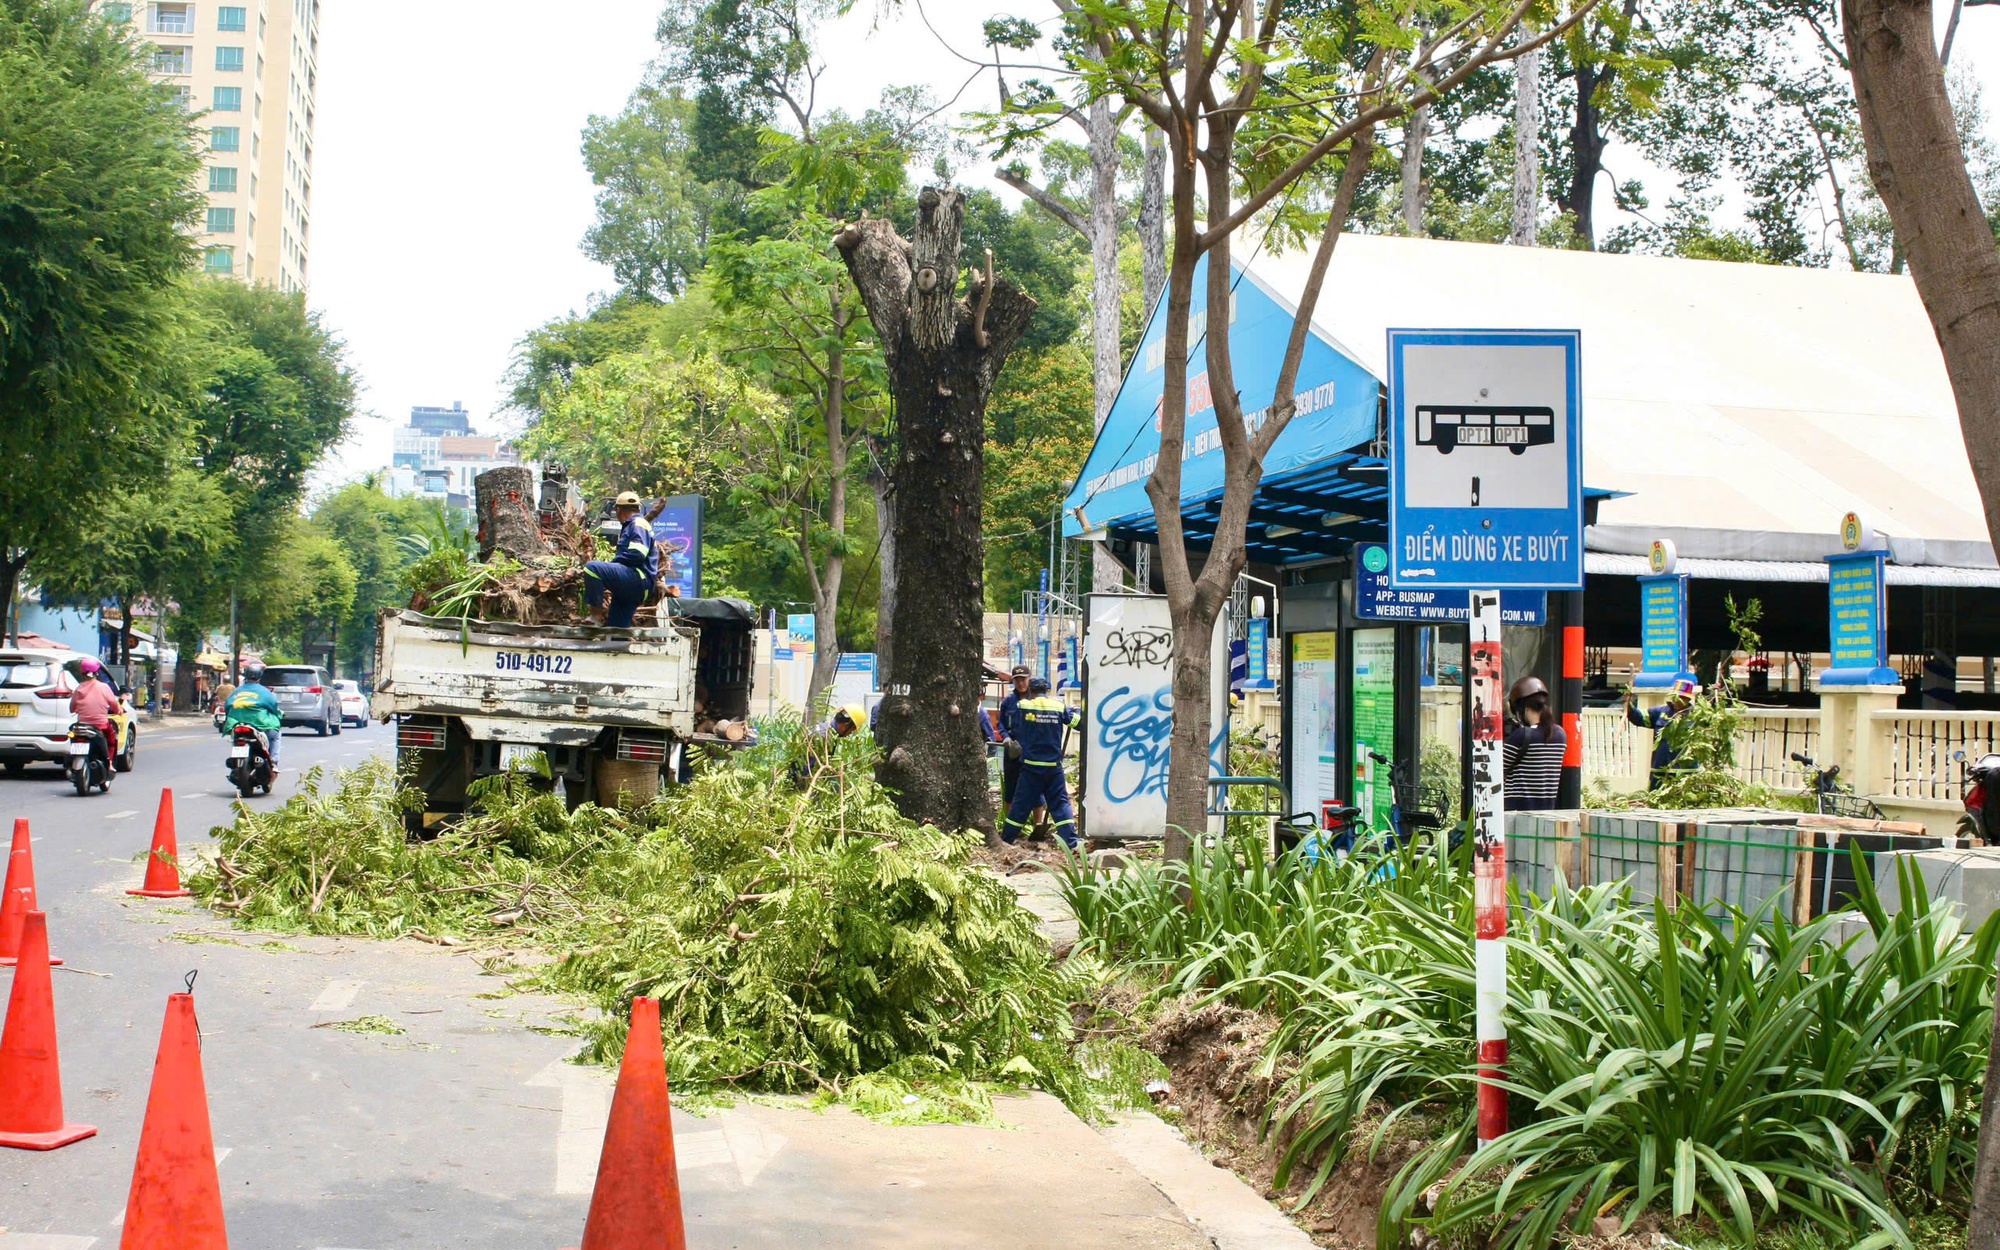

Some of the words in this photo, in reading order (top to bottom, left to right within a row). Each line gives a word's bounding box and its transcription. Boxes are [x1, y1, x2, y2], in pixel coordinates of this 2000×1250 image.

[1314, 380, 1335, 412] 9778
[1404, 524, 1446, 562] ĐIỂM
[1451, 529, 1497, 562] DỪNG
[1501, 535, 1523, 562] XE
[1527, 529, 1569, 562] BUÝT
[1375, 591, 1396, 602] APP:
[1399, 592, 1435, 604] BUSMAP
[1375, 605, 1418, 617] WEBSITE:
[495, 651, 573, 675] 51D-491.22
